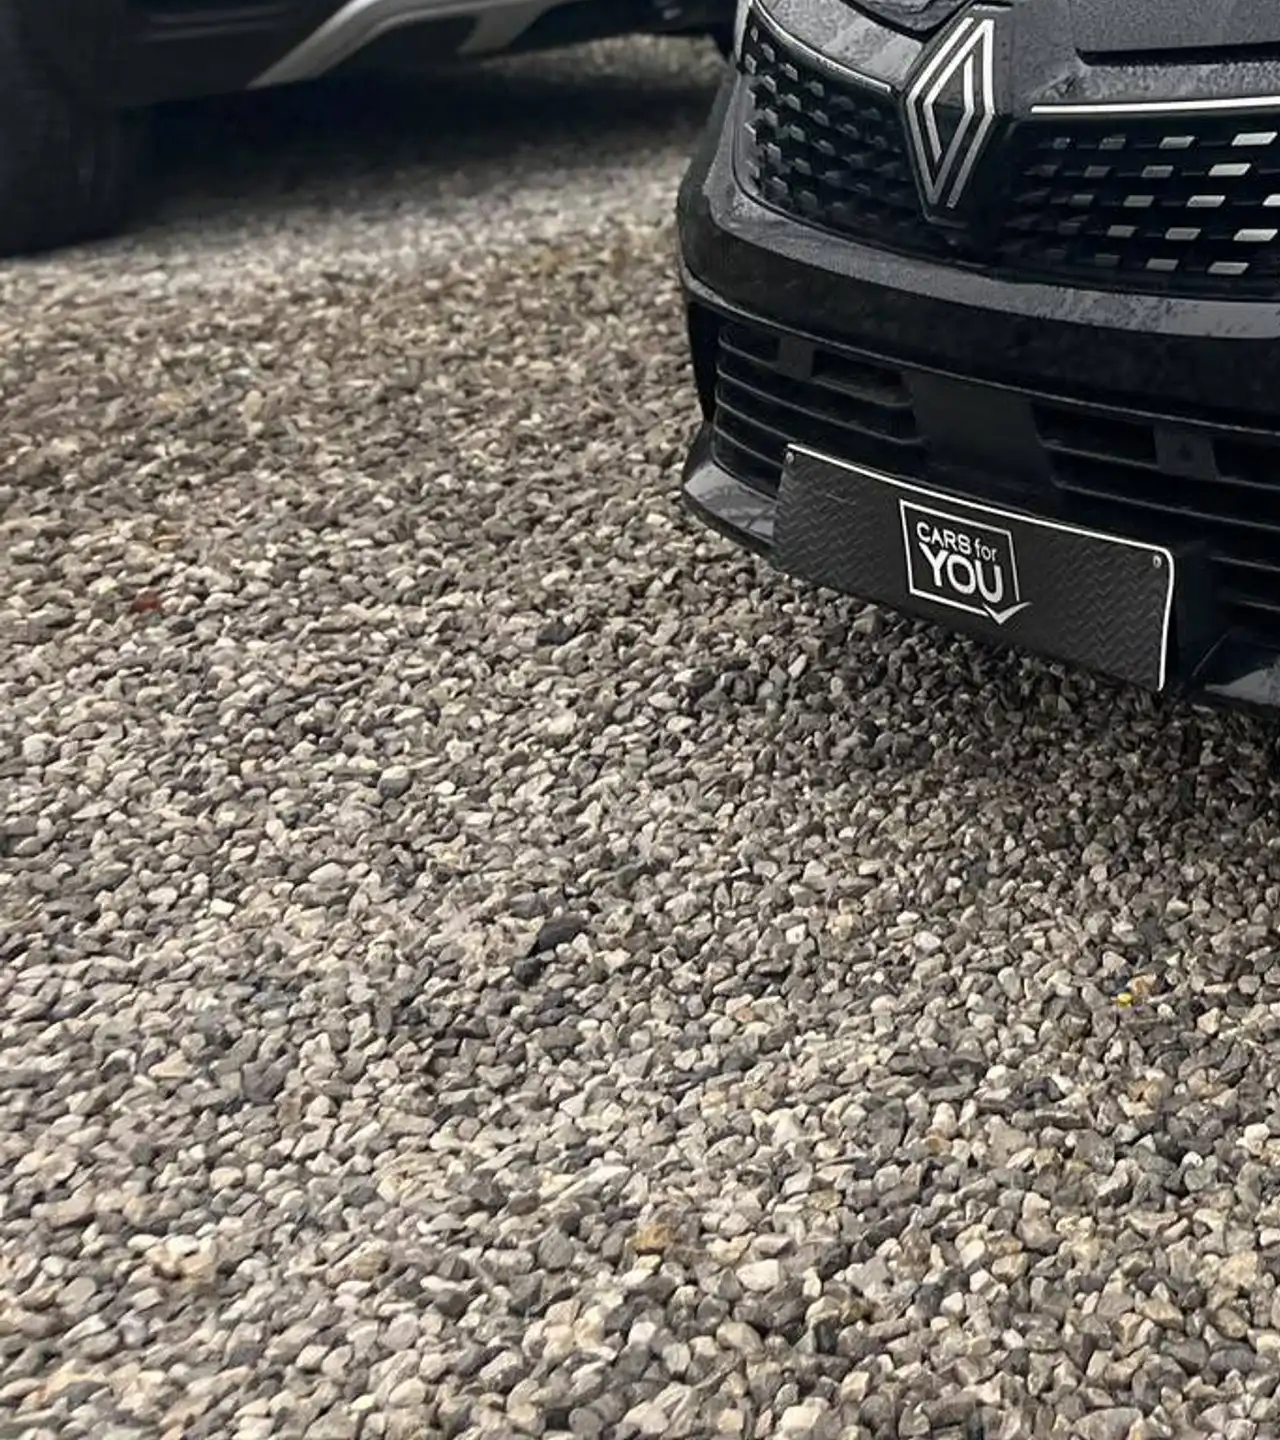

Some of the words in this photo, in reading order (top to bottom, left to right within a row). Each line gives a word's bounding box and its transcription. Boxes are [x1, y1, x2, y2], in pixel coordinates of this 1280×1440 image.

[916, 520, 972, 556] CARS
[974, 537, 998, 563] for
[918, 541, 1003, 603] YOU
